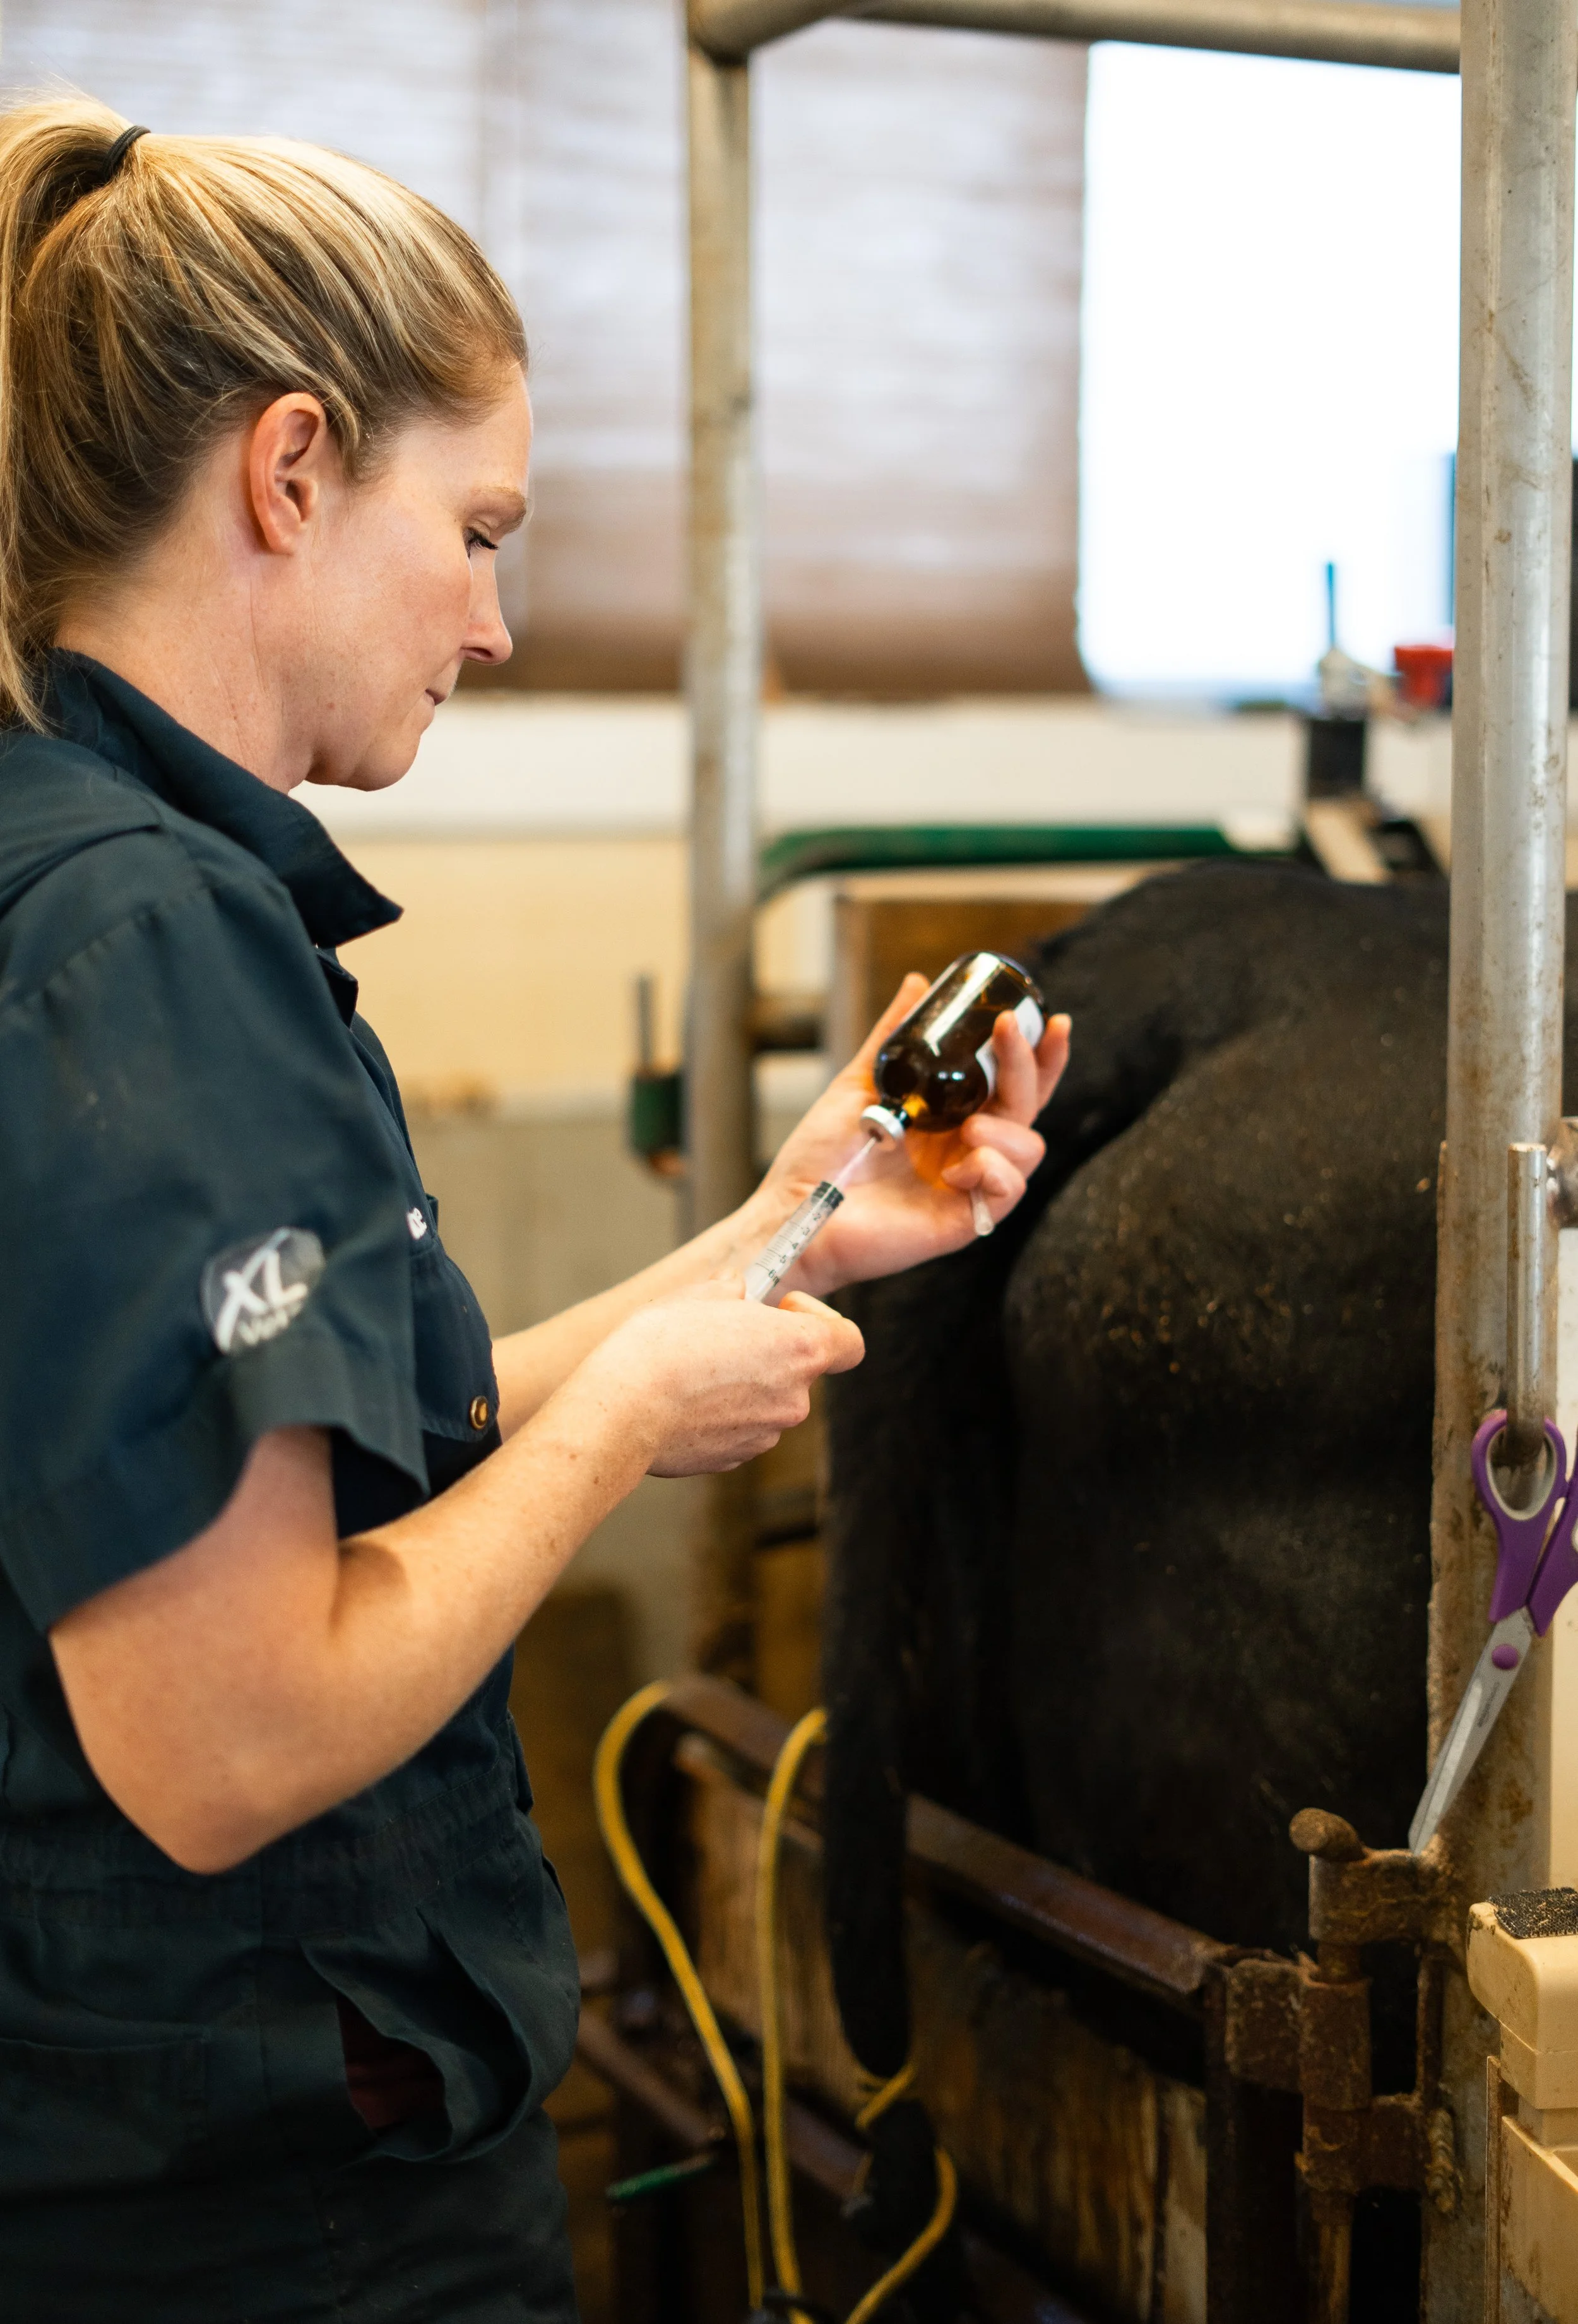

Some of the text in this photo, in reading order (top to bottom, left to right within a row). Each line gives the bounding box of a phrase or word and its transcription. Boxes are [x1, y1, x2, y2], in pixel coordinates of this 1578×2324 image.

[802, 1226, 810, 1236] 3
[780, 1254, 787, 1264] 5
[768, 1269, 776, 1278] 6
[216, 1226, 307, 1352] XL
